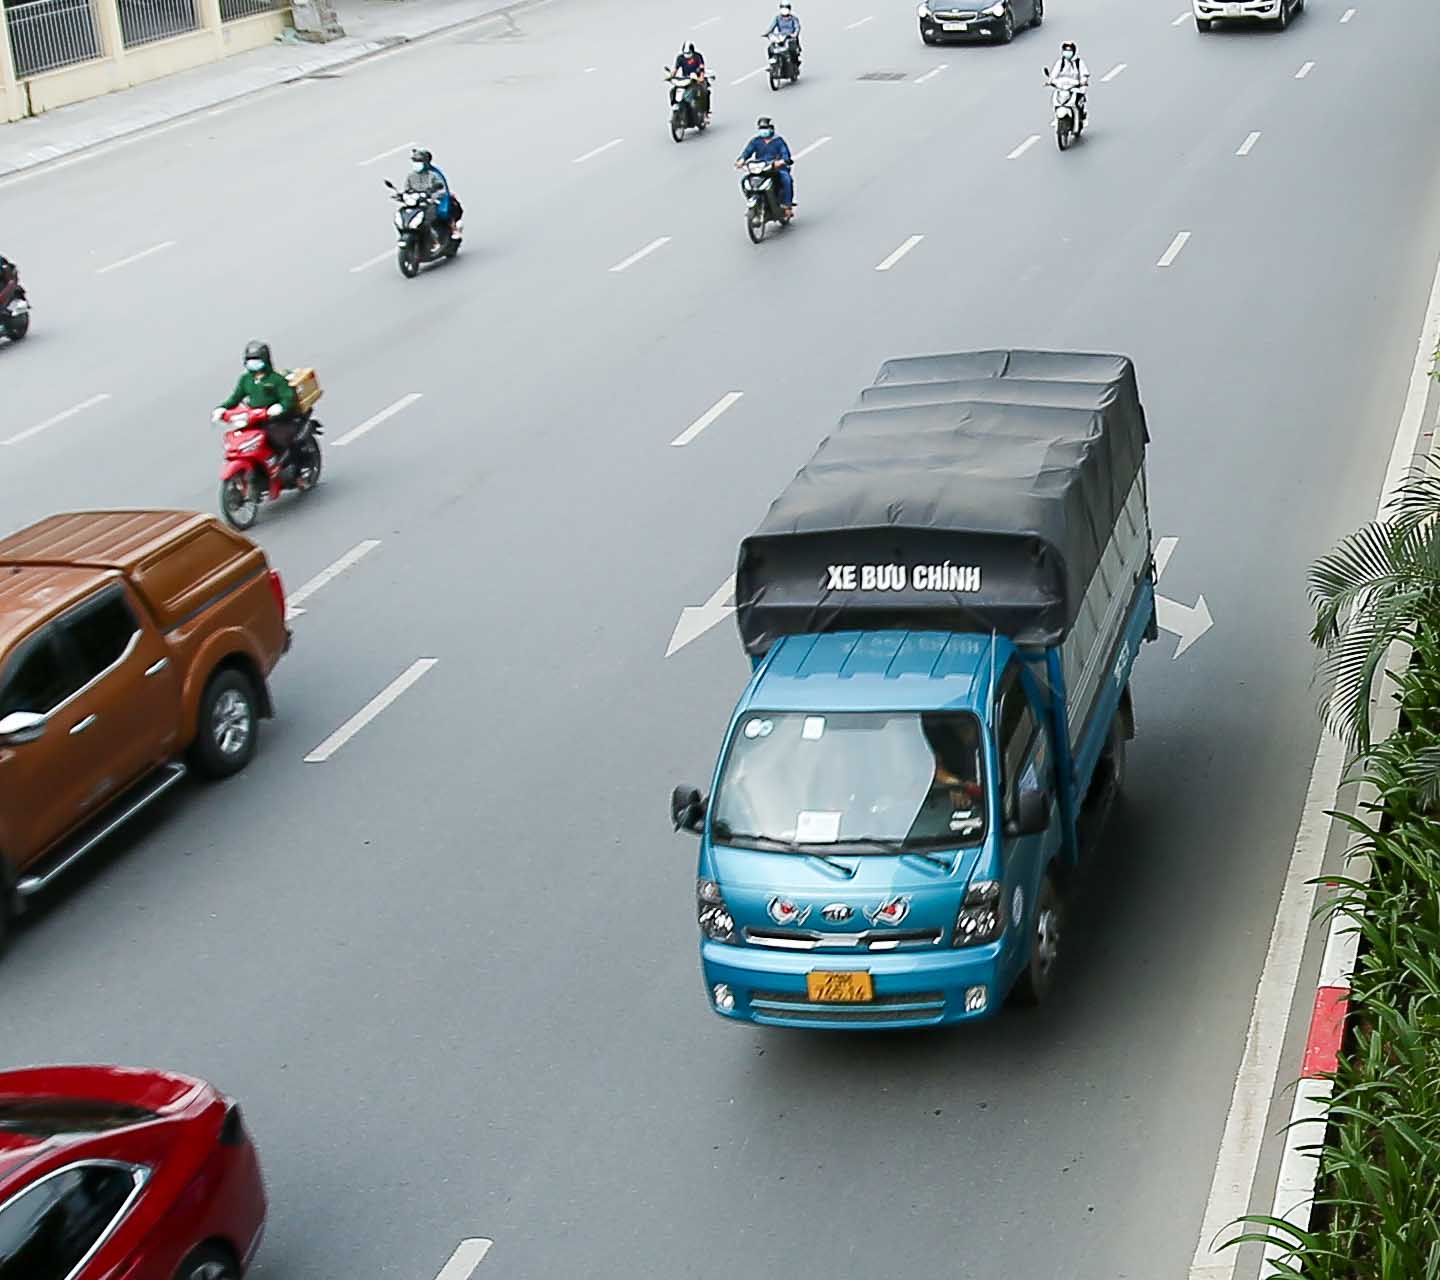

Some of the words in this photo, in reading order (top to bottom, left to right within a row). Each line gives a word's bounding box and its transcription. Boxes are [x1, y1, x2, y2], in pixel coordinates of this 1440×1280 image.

[827, 565, 857, 591] XE
[861, 563, 907, 592] BƯU
[913, 560, 981, 592] CHÍNH
